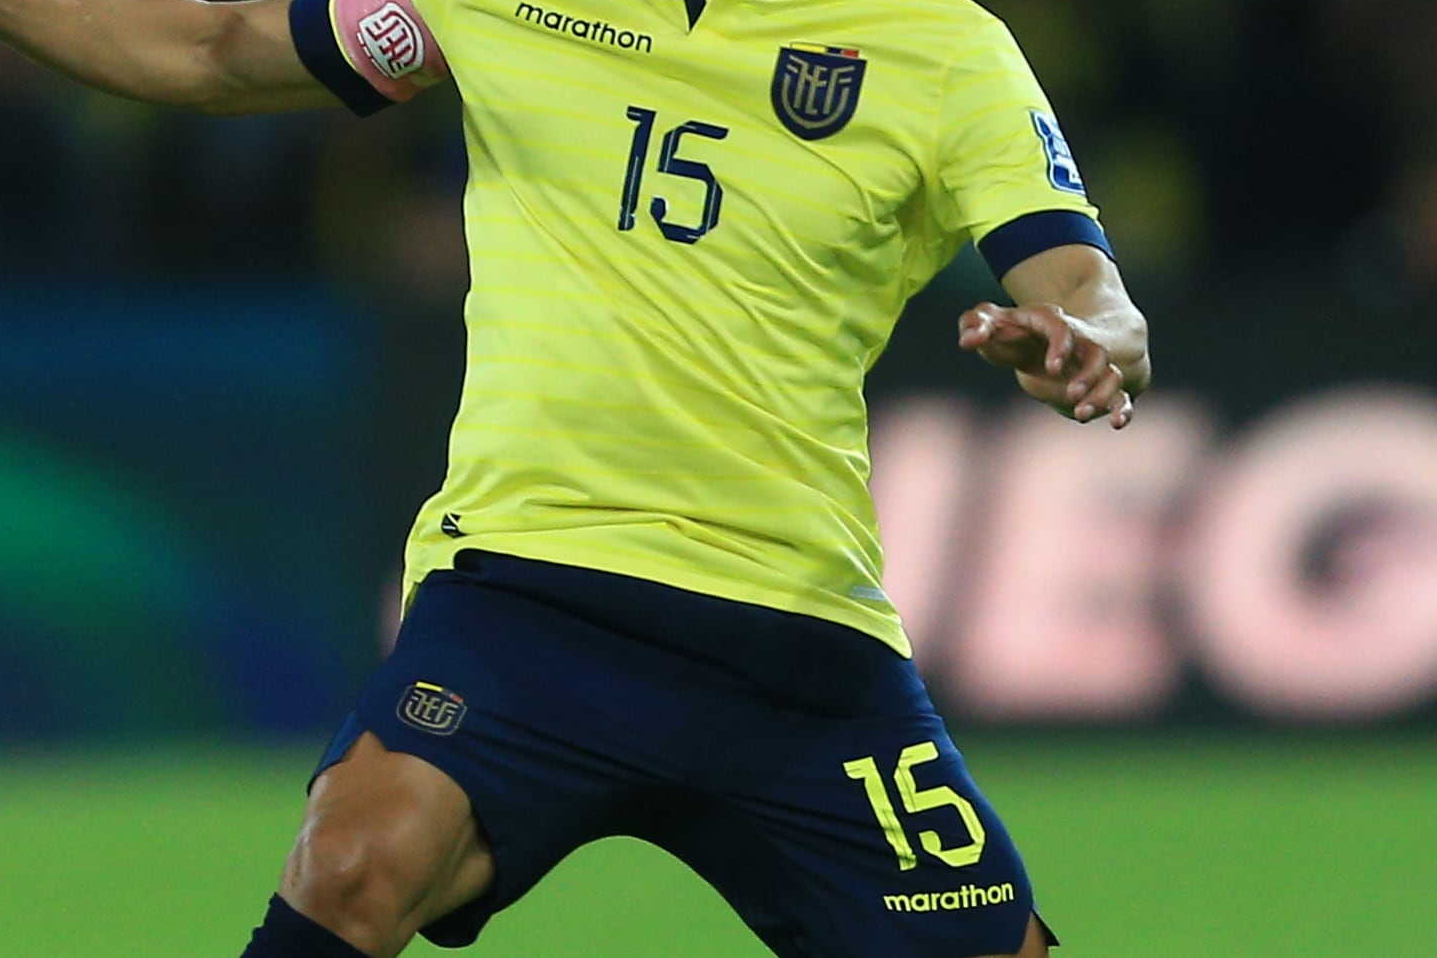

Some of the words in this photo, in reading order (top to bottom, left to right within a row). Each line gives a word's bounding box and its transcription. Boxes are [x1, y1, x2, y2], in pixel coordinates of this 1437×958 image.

[514, 2, 653, 53] marathon
[617, 105, 729, 245] 15
[842, 740, 986, 871] 15
[883, 882, 1015, 912] marathon
